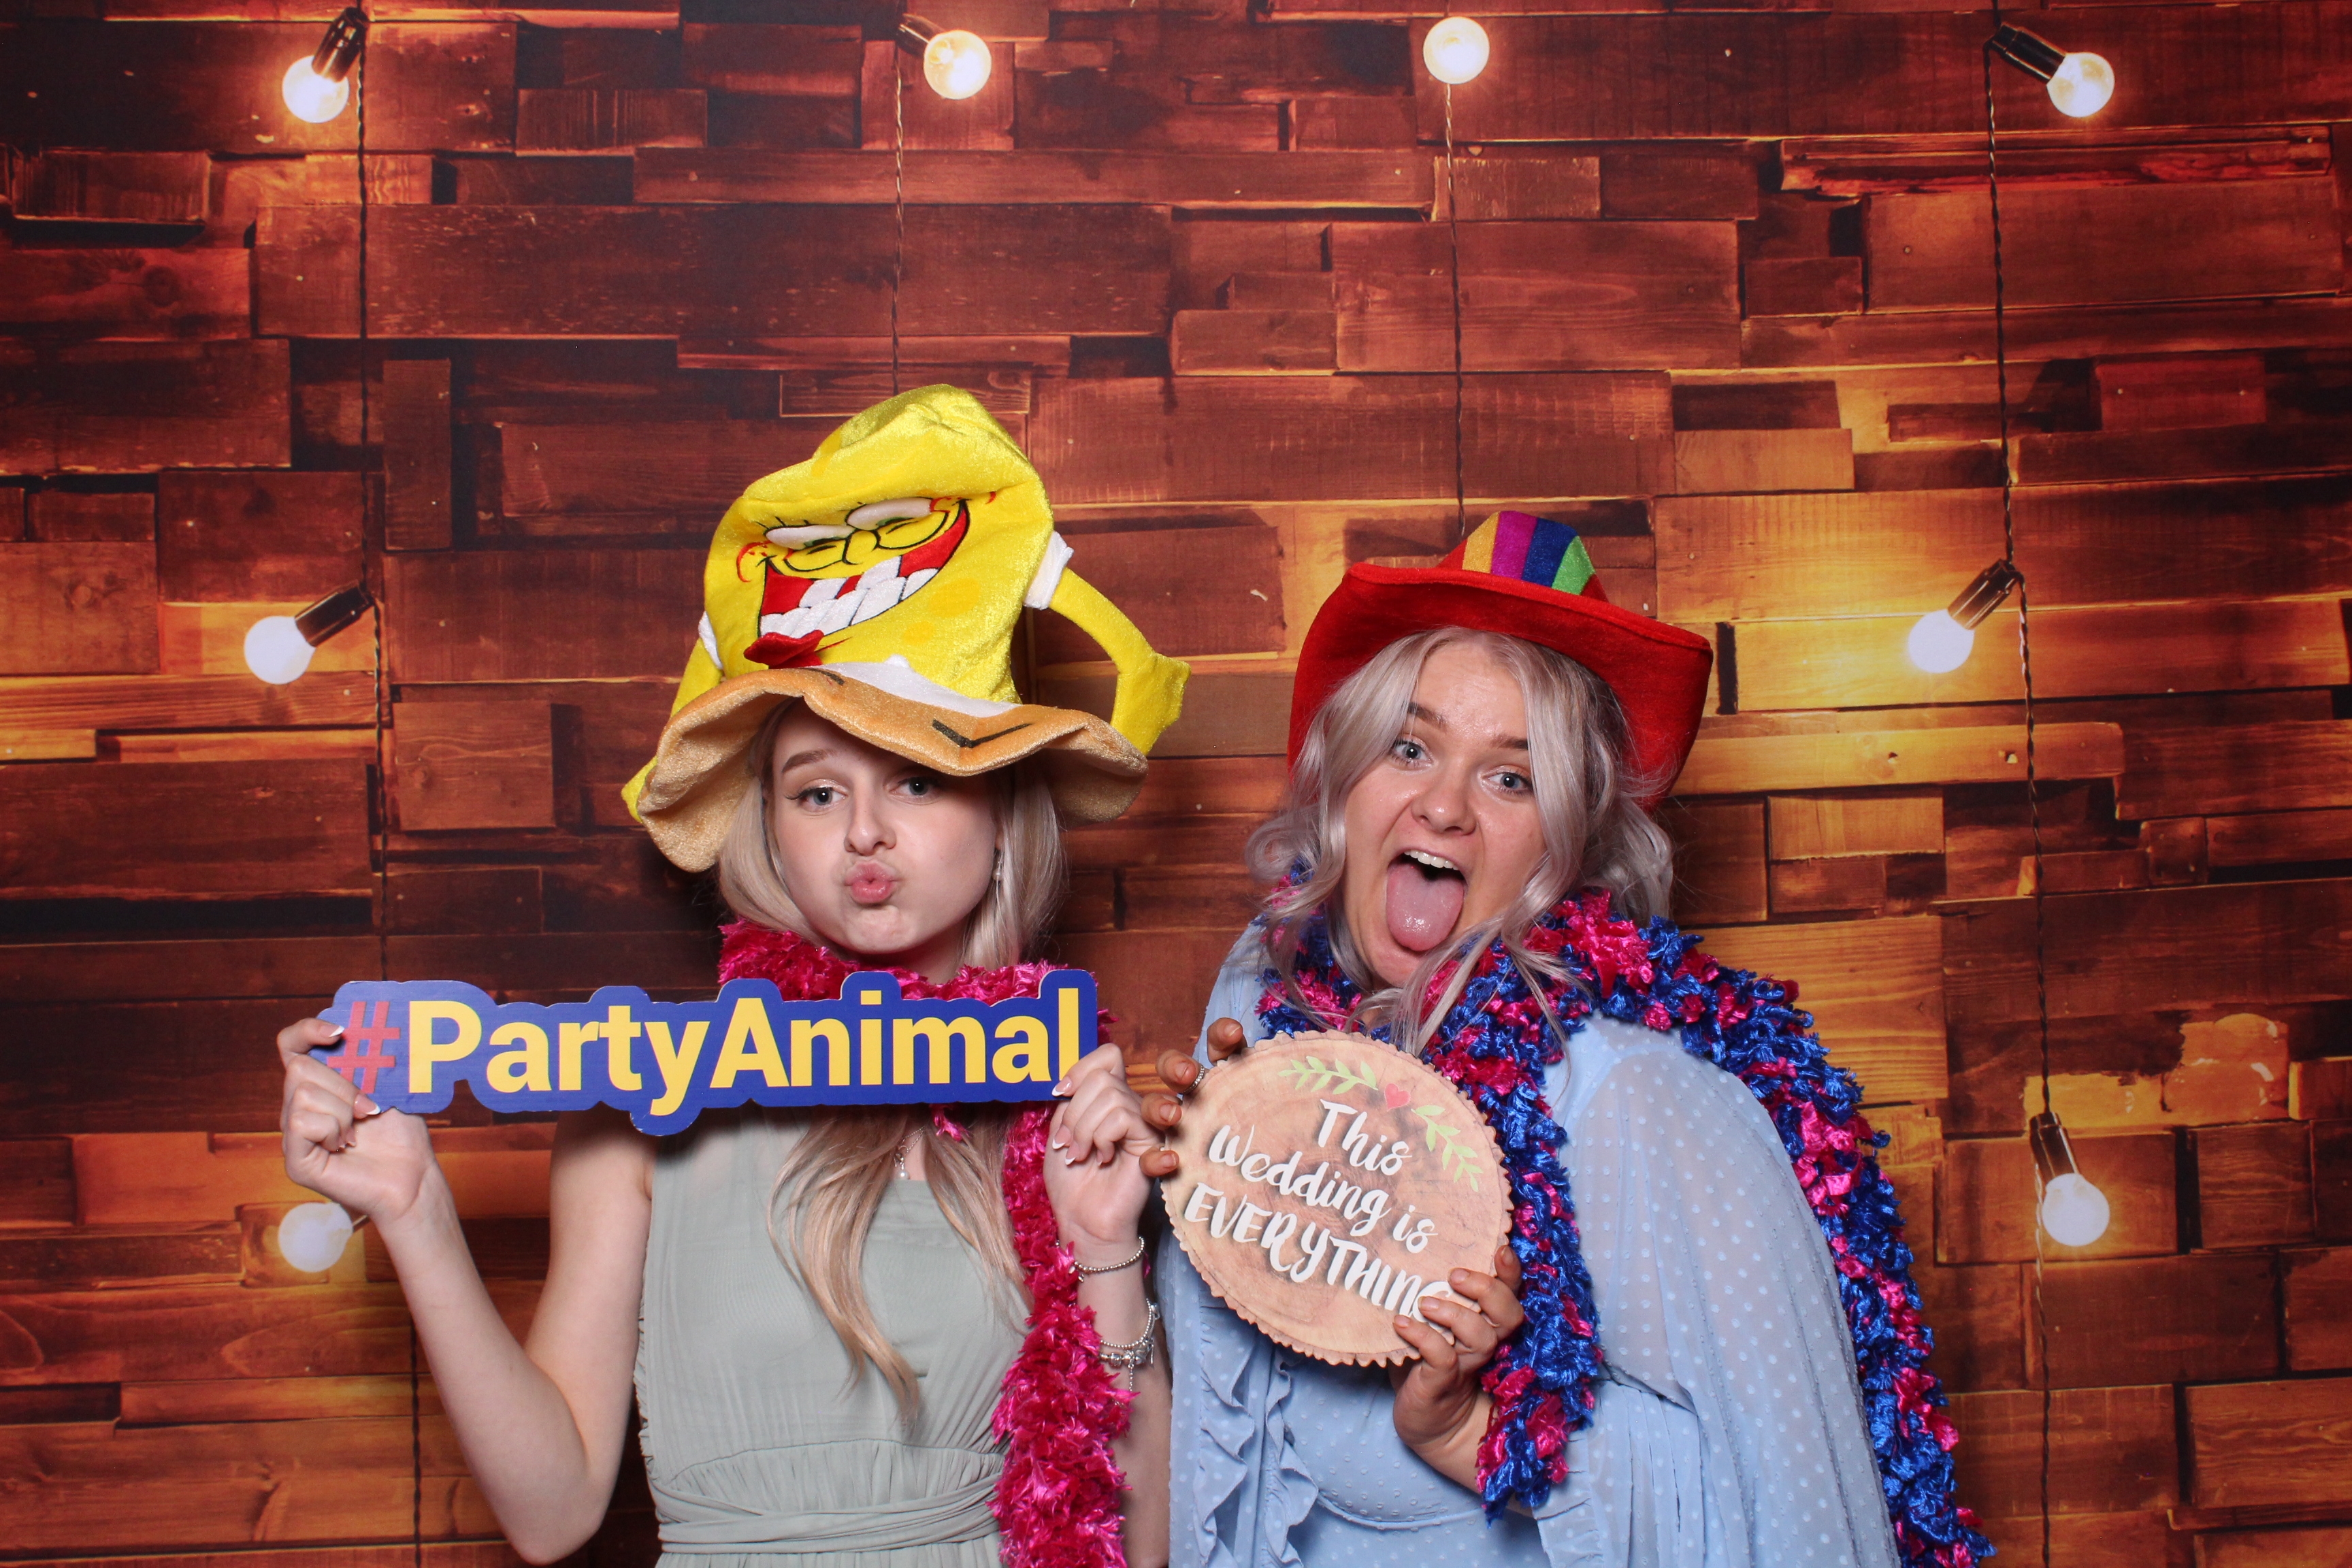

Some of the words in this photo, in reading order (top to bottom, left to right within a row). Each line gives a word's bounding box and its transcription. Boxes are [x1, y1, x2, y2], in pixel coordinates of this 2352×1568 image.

[327, 987, 1079, 1117] #PartyAnimal
[1209, 1124, 1392, 1237] Wedding
[1393, 1205, 1439, 1254] is
[1318, 1098, 1412, 1176] This
